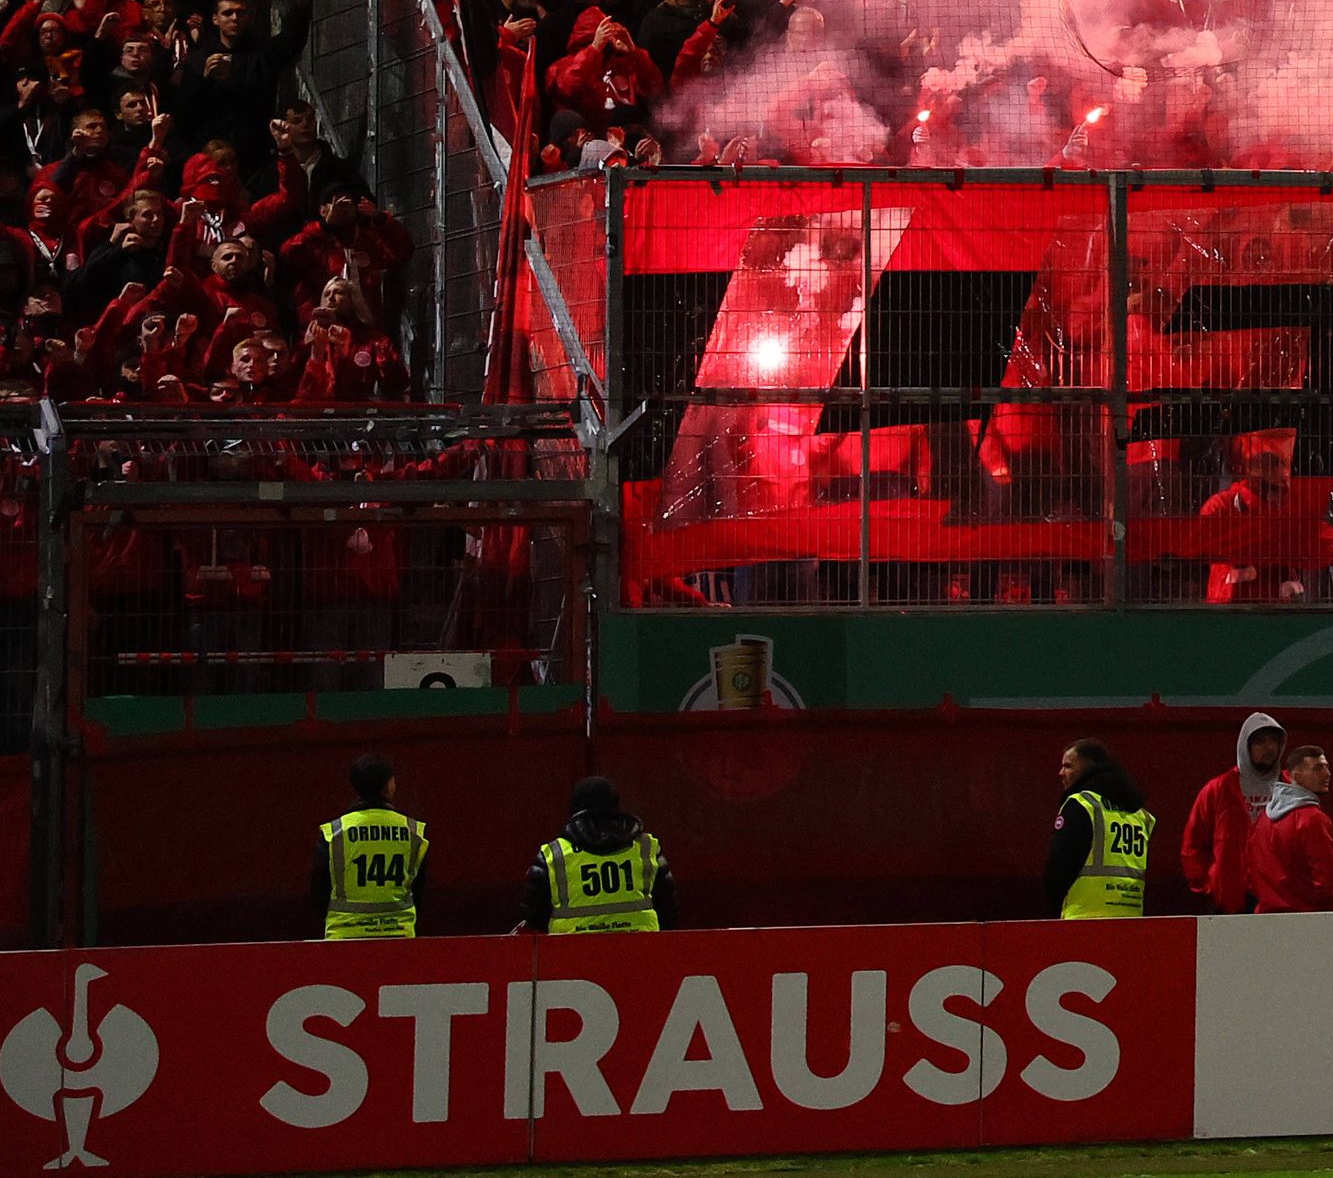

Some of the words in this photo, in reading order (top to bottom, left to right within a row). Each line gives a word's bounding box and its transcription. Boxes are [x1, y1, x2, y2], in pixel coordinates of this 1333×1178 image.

[347, 825, 409, 842] ORDNER
[1110, 821, 1146, 858] 295
[352, 853, 405, 887] 144
[580, 859, 634, 897] 501
[259, 961, 1120, 1129] STRAUSS
